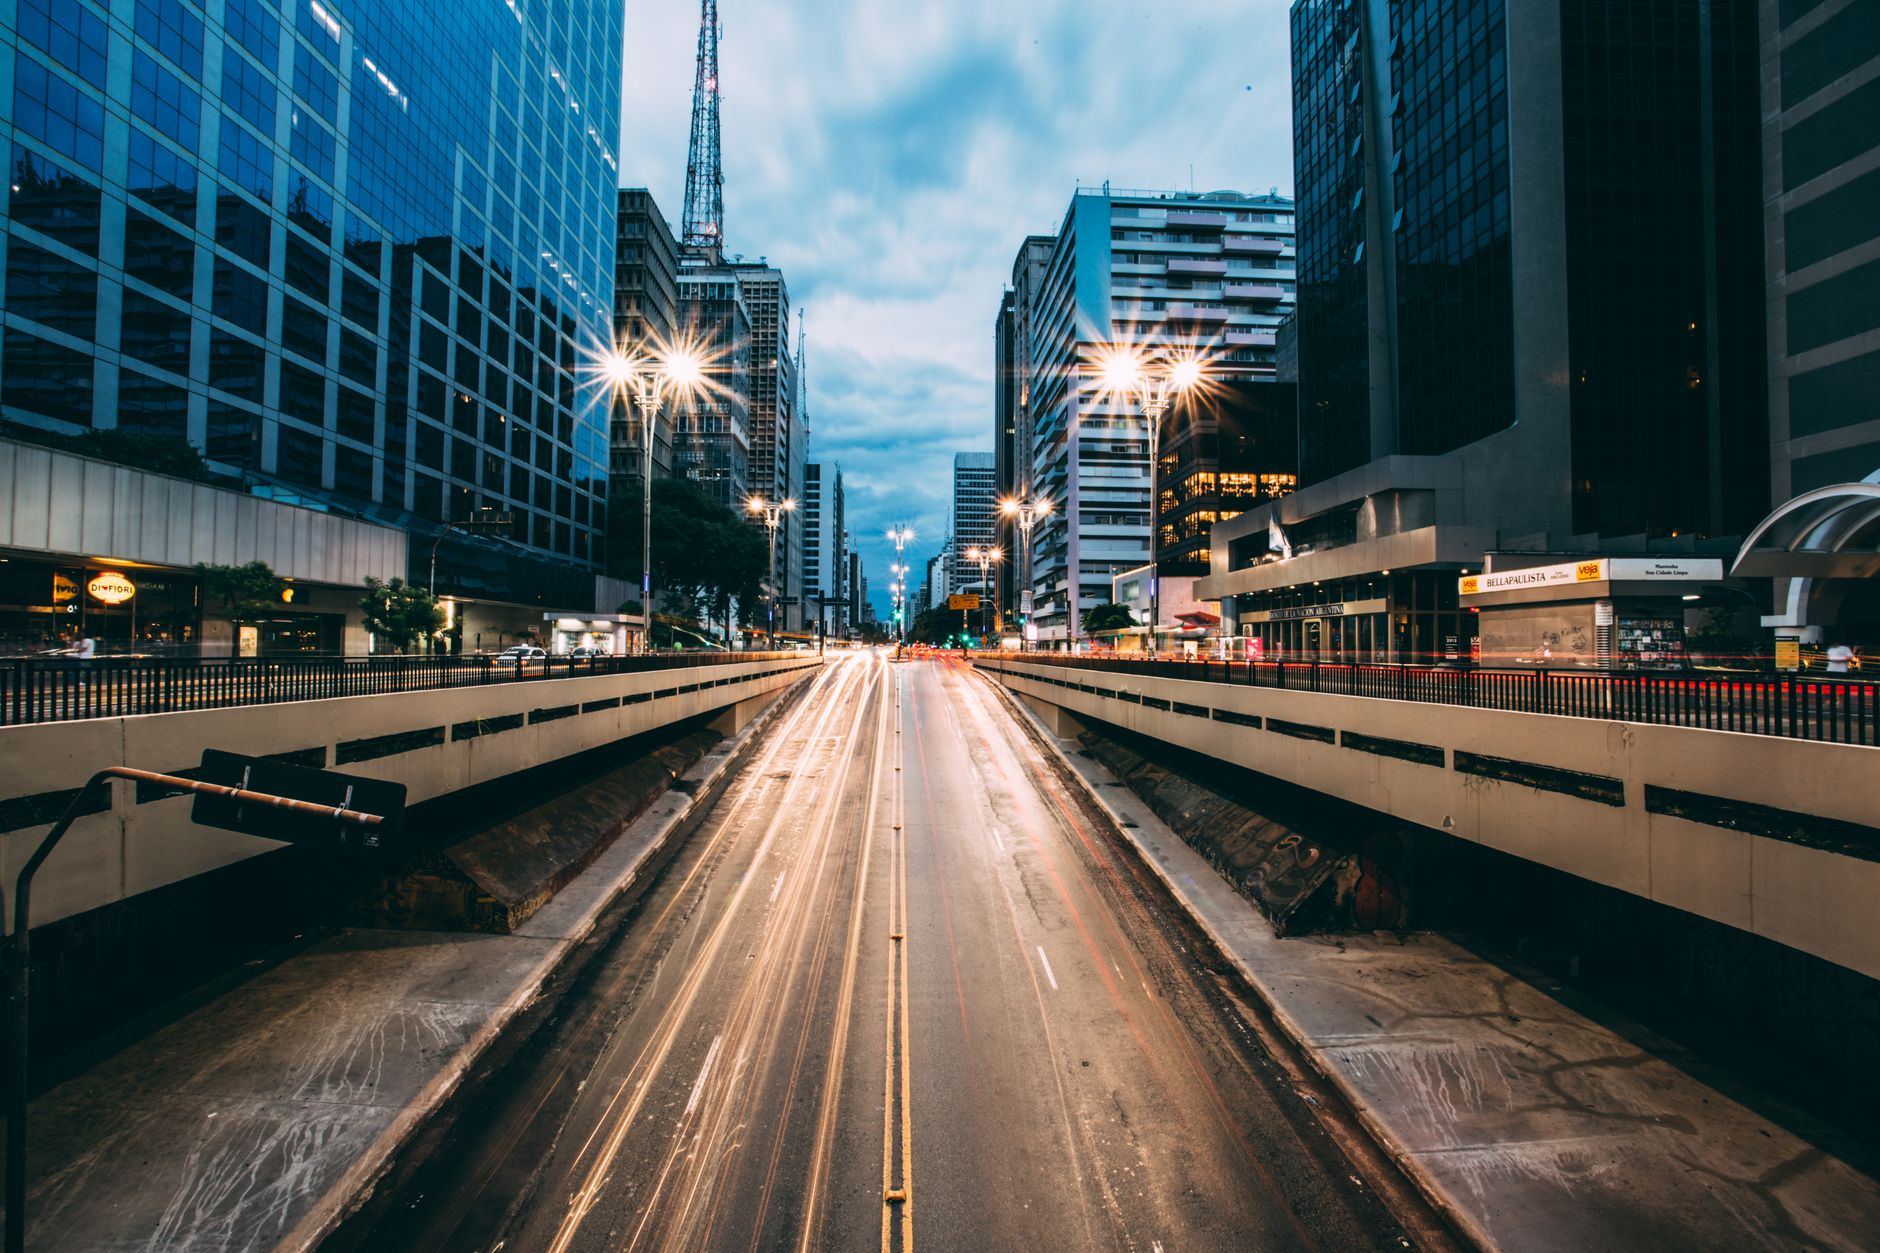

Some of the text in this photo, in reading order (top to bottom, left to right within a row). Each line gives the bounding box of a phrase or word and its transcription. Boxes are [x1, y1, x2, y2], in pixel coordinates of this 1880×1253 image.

[1579, 563, 1598, 576] veja
[1463, 578, 1477, 589] veja
[1487, 572, 1545, 587] BELLAPAULISTA
